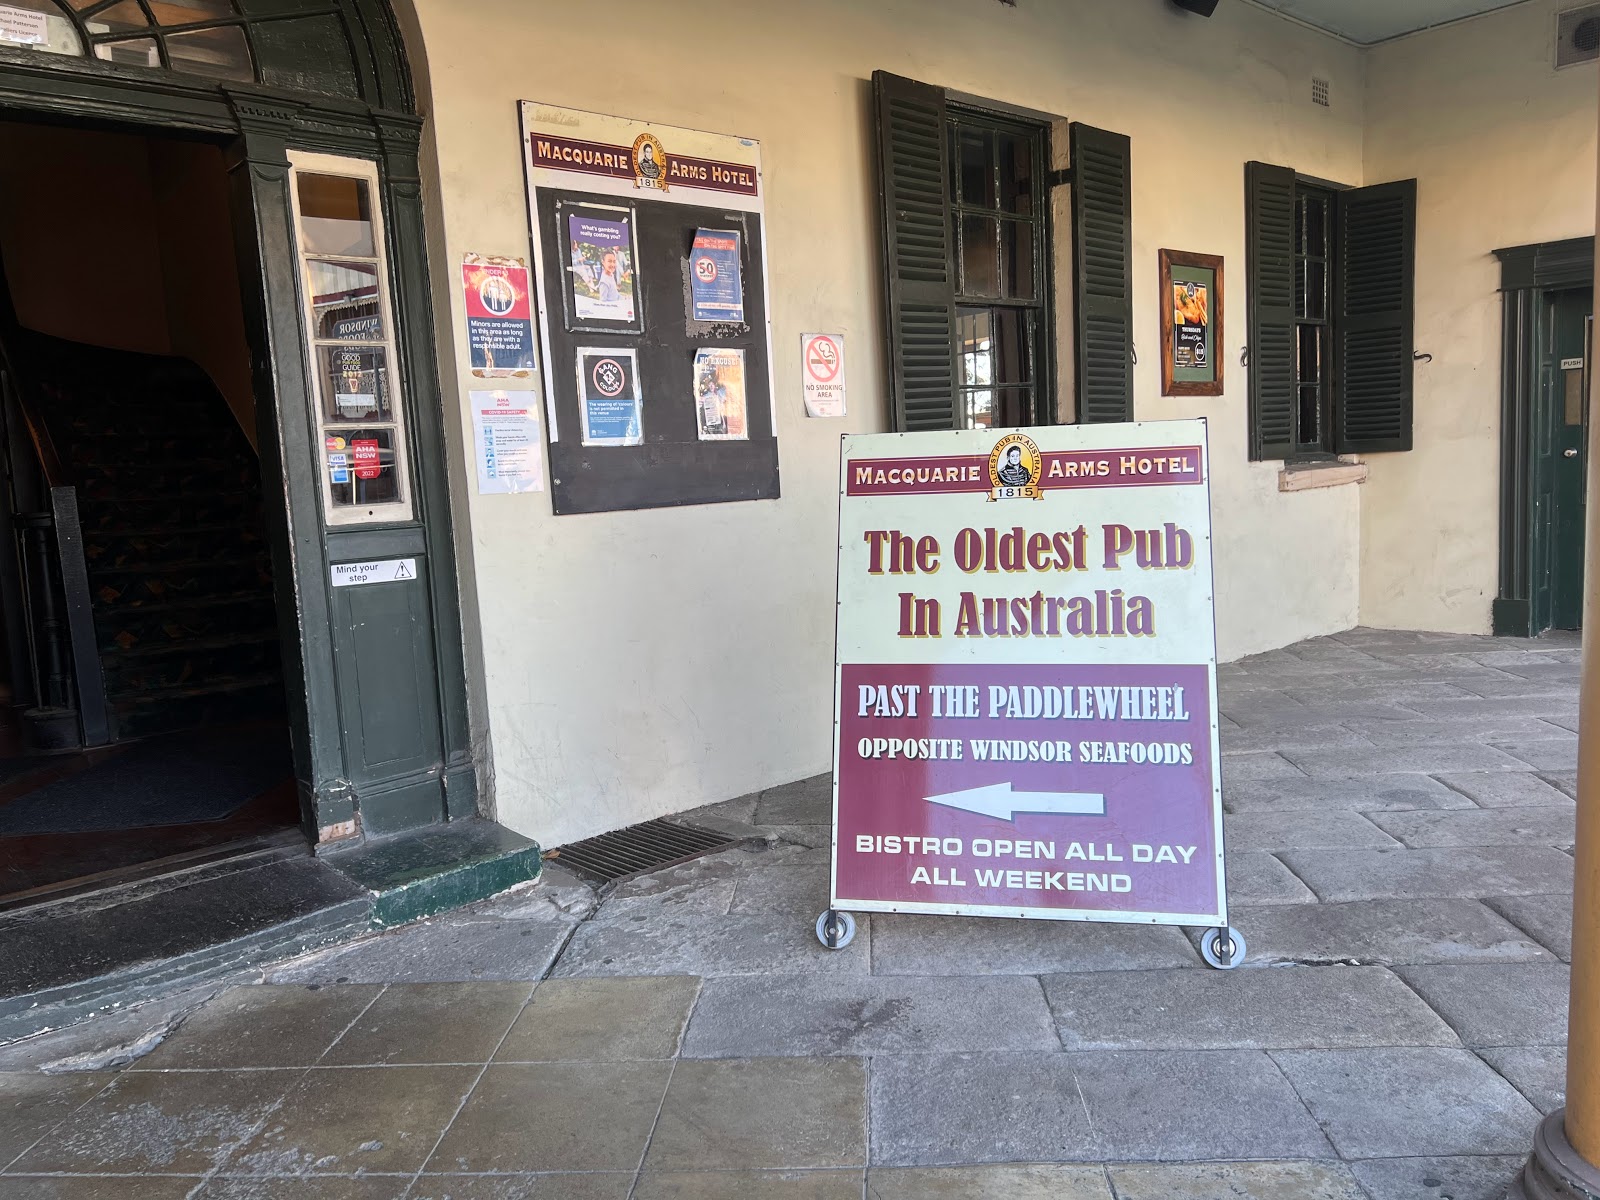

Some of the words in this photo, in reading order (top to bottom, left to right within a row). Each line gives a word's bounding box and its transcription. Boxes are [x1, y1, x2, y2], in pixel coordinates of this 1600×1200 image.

[640, 178, 662, 188] 1815
[670, 161, 707, 181] ARMS
[712, 166, 753, 187] HOTEL
[598, 364, 618, 374] GANG
[855, 465, 981, 486] MACQUARIE
[1048, 459, 1110, 478] ARMS
[1120, 455, 1195, 476] HOTEL
[990, 453, 1000, 486] OLDEST
[995, 437, 1010, 452] PUB
[1024, 440, 1040, 484] AUSTRALIA
[998, 488, 1033, 497] 1815
[863, 529, 941, 575] The
[953, 524, 1089, 573] Oldest
[1101, 522, 1195, 571] Pub
[336, 565, 358, 574] Mind
[360, 564, 378, 573] your
[349, 574, 368, 582] step
[897, 592, 941, 638] In
[954, 588, 1156, 638] Australia
[857, 685, 920, 718] PAST
[929, 685, 980, 719] THE
[988, 685, 1190, 721] PADDLEWHEEL
[857, 737, 963, 760] OPPOSITE
[970, 739, 1072, 763] WINDSOR
[1079, 741, 1193, 765] SEAFOODS
[855, 835, 963, 857] BISTRO
[972, 838, 1056, 860] OPEN
[1064, 841, 1123, 862] ALL
[1132, 844, 1198, 865] DAY
[910, 866, 966, 887] ALL
[974, 868, 1132, 893] WEEKEND
